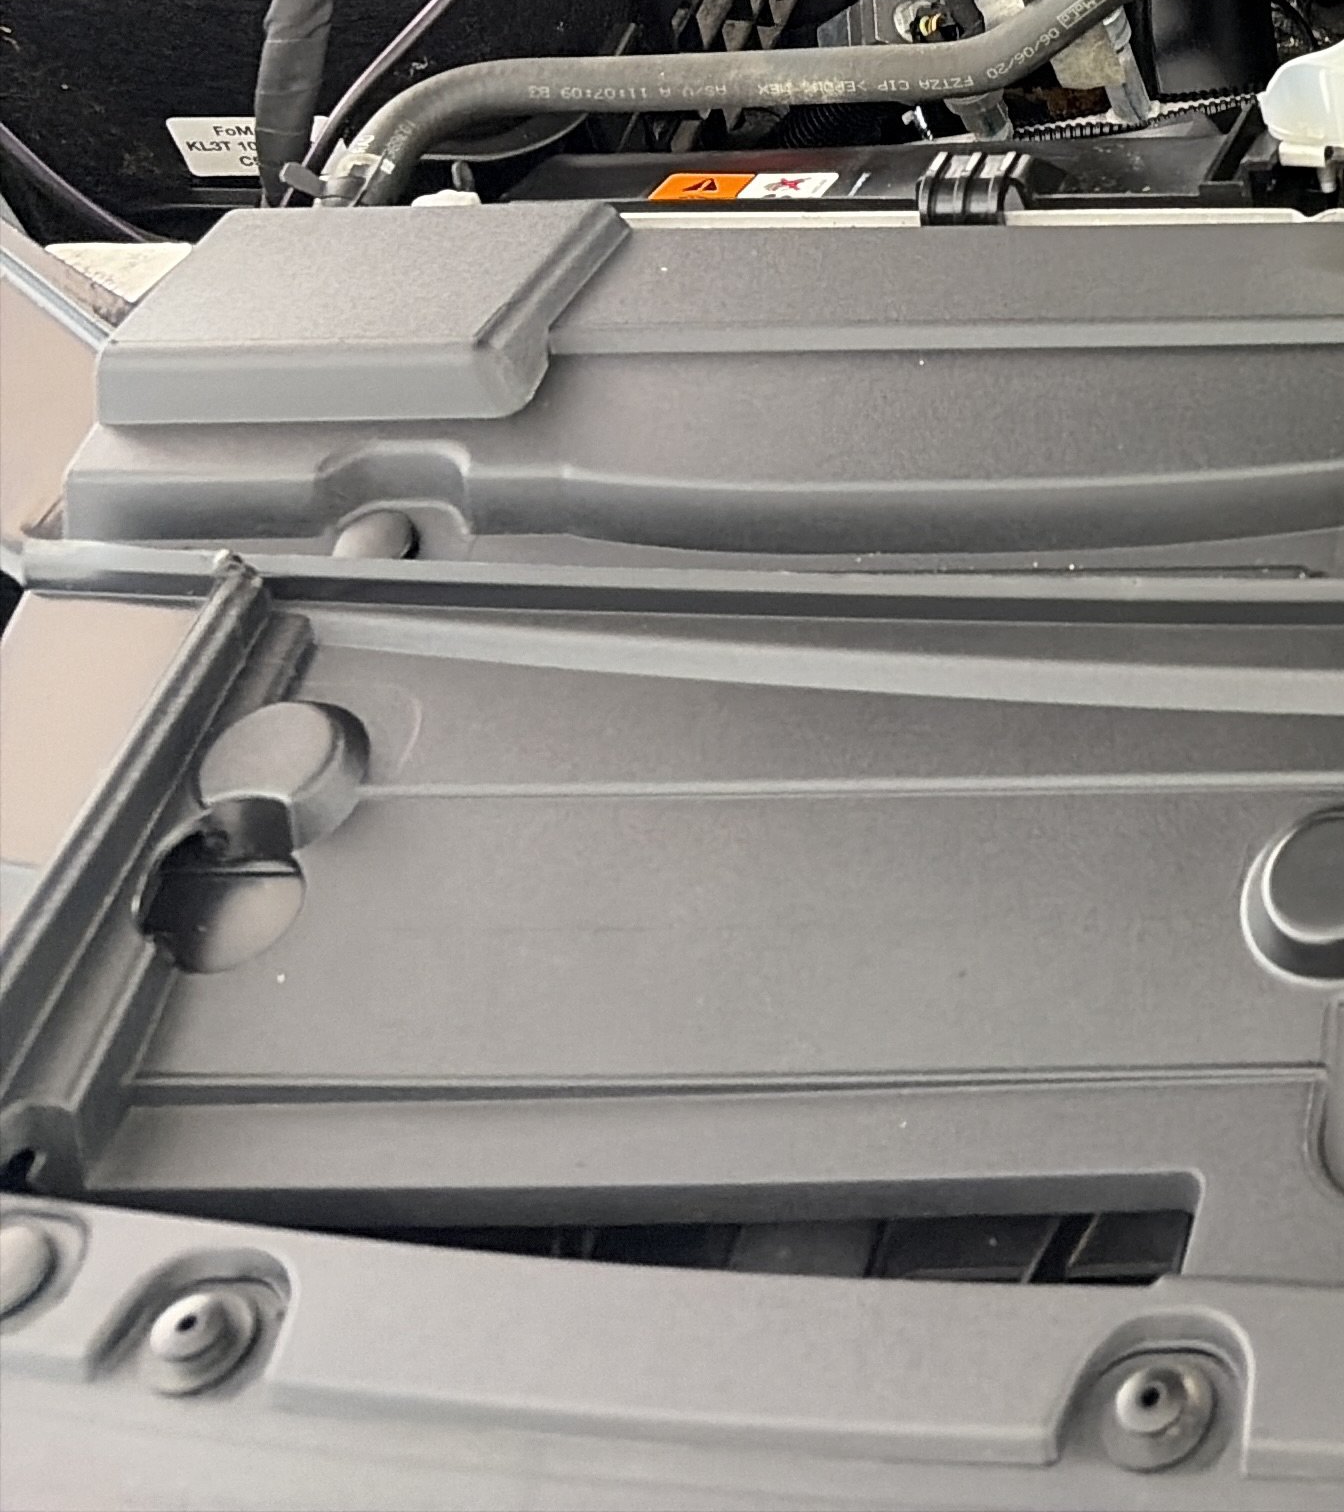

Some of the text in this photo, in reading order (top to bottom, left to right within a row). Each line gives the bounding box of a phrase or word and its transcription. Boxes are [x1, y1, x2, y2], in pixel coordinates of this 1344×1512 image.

[986, 26, 1060, 80] 06/06/20
[877, 79, 910, 92] CIP
[560, 86, 648, 100] 11:07:09
[212, 125, 256, 137] FoM
[185, 140, 258, 152] KL3T 10
